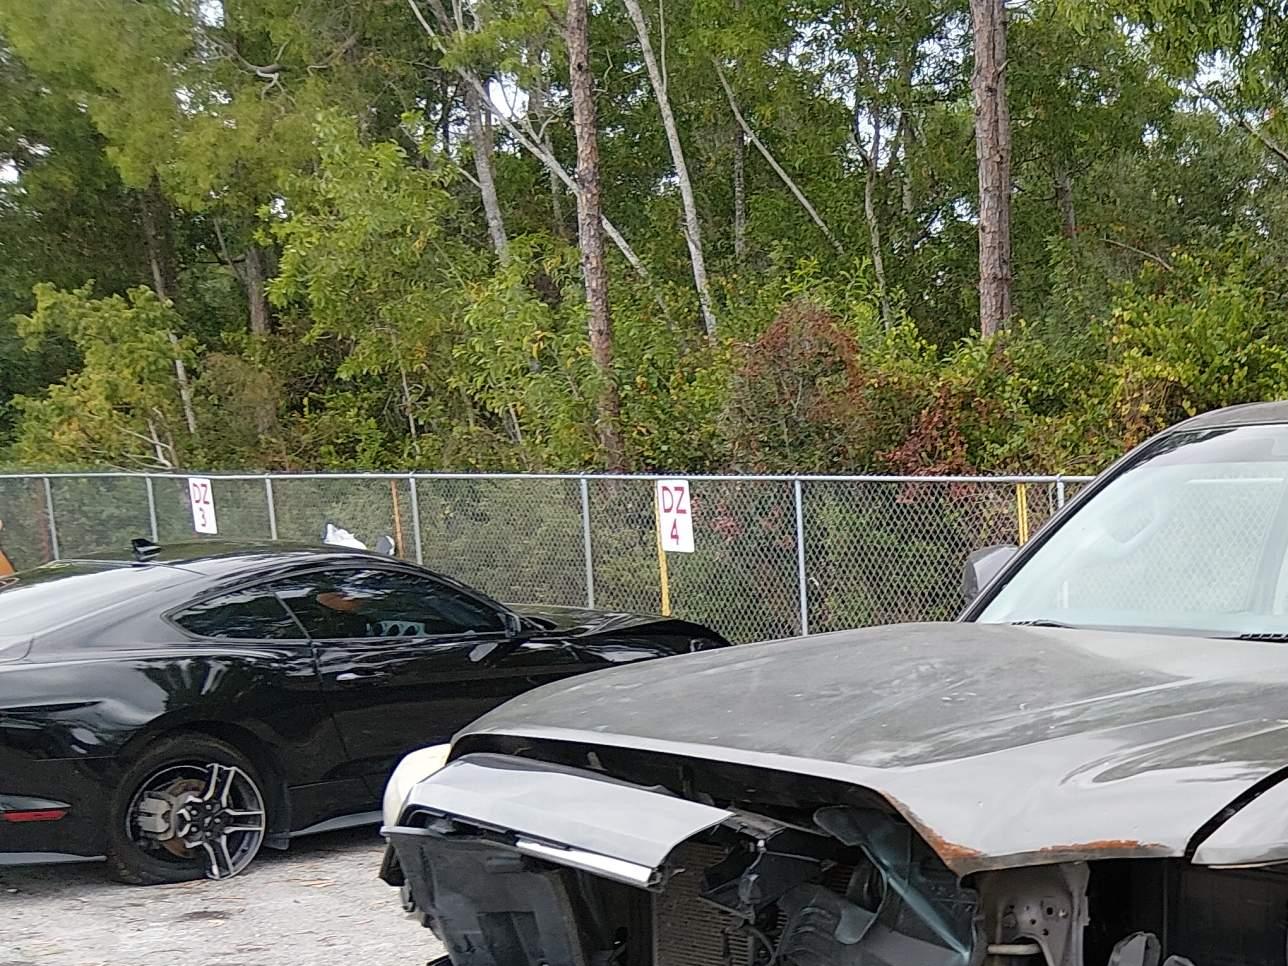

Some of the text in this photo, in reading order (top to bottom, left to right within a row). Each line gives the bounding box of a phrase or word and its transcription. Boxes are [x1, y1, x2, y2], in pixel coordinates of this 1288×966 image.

[192, 483, 210, 504] DZ
[661, 486, 687, 514] DZ
[670, 518, 680, 545] 4
